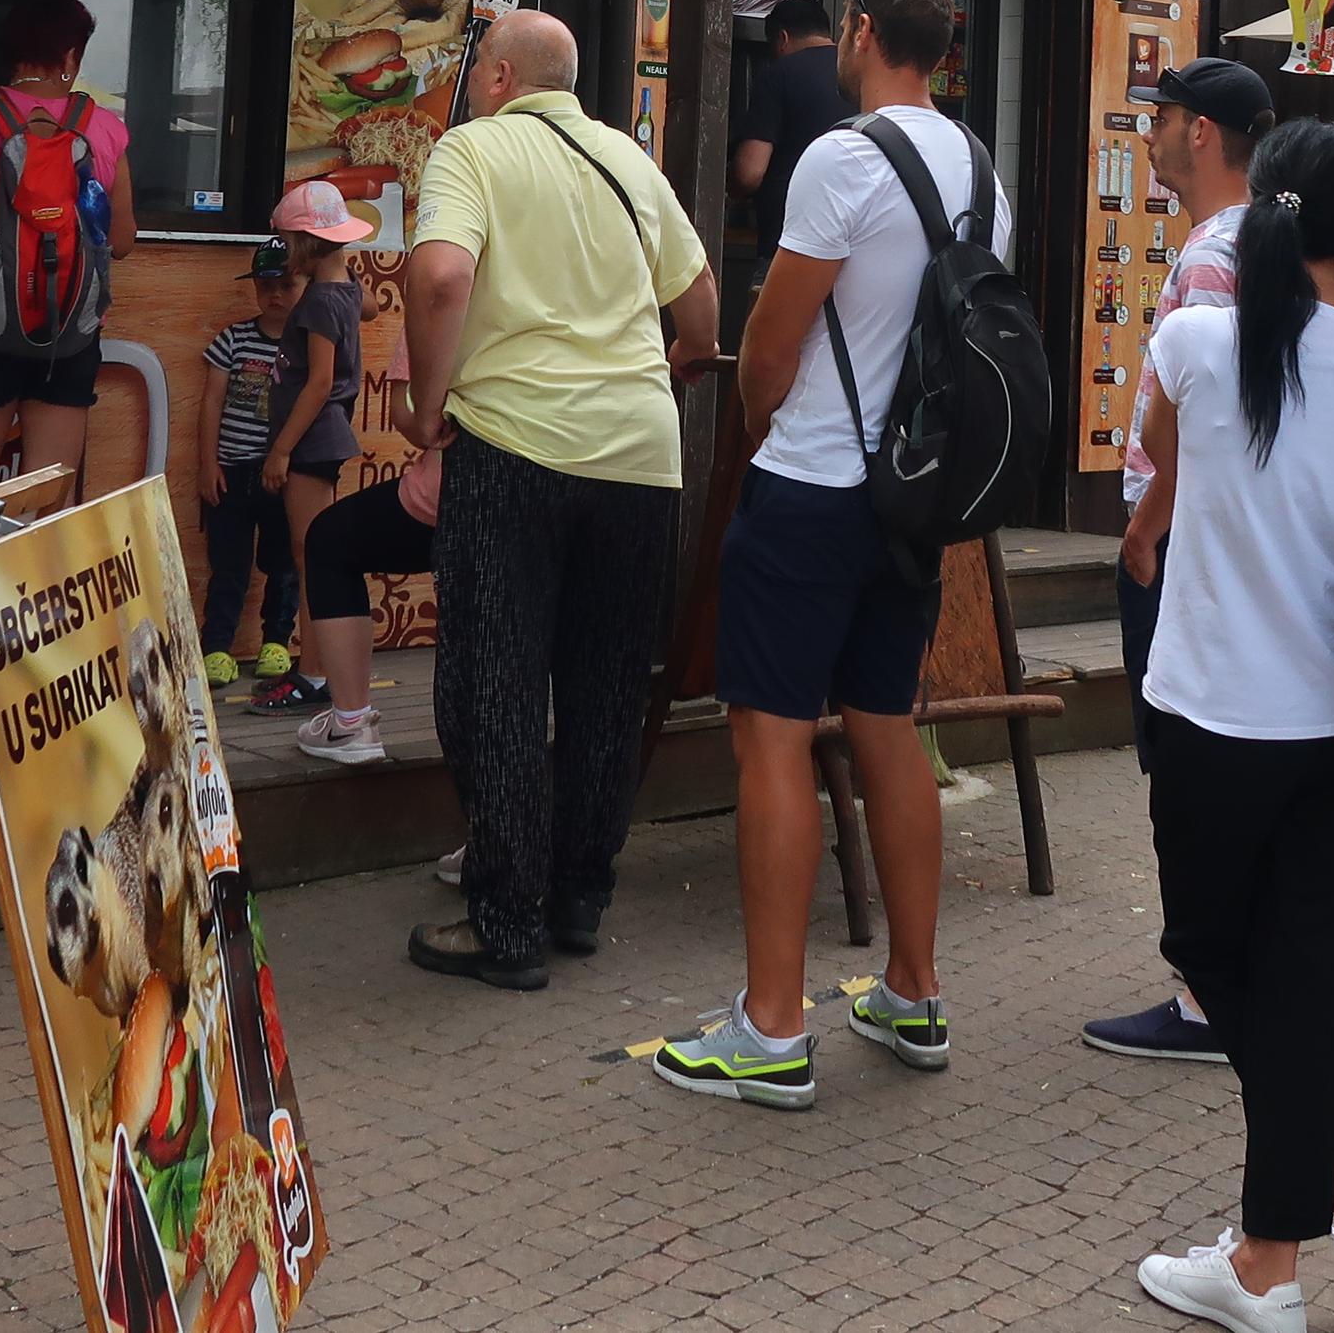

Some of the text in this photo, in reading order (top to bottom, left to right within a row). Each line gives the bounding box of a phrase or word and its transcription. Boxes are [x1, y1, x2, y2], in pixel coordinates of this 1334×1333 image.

[1, 645, 124, 765] U SURIKAT
[195, 774, 228, 831] kofola
